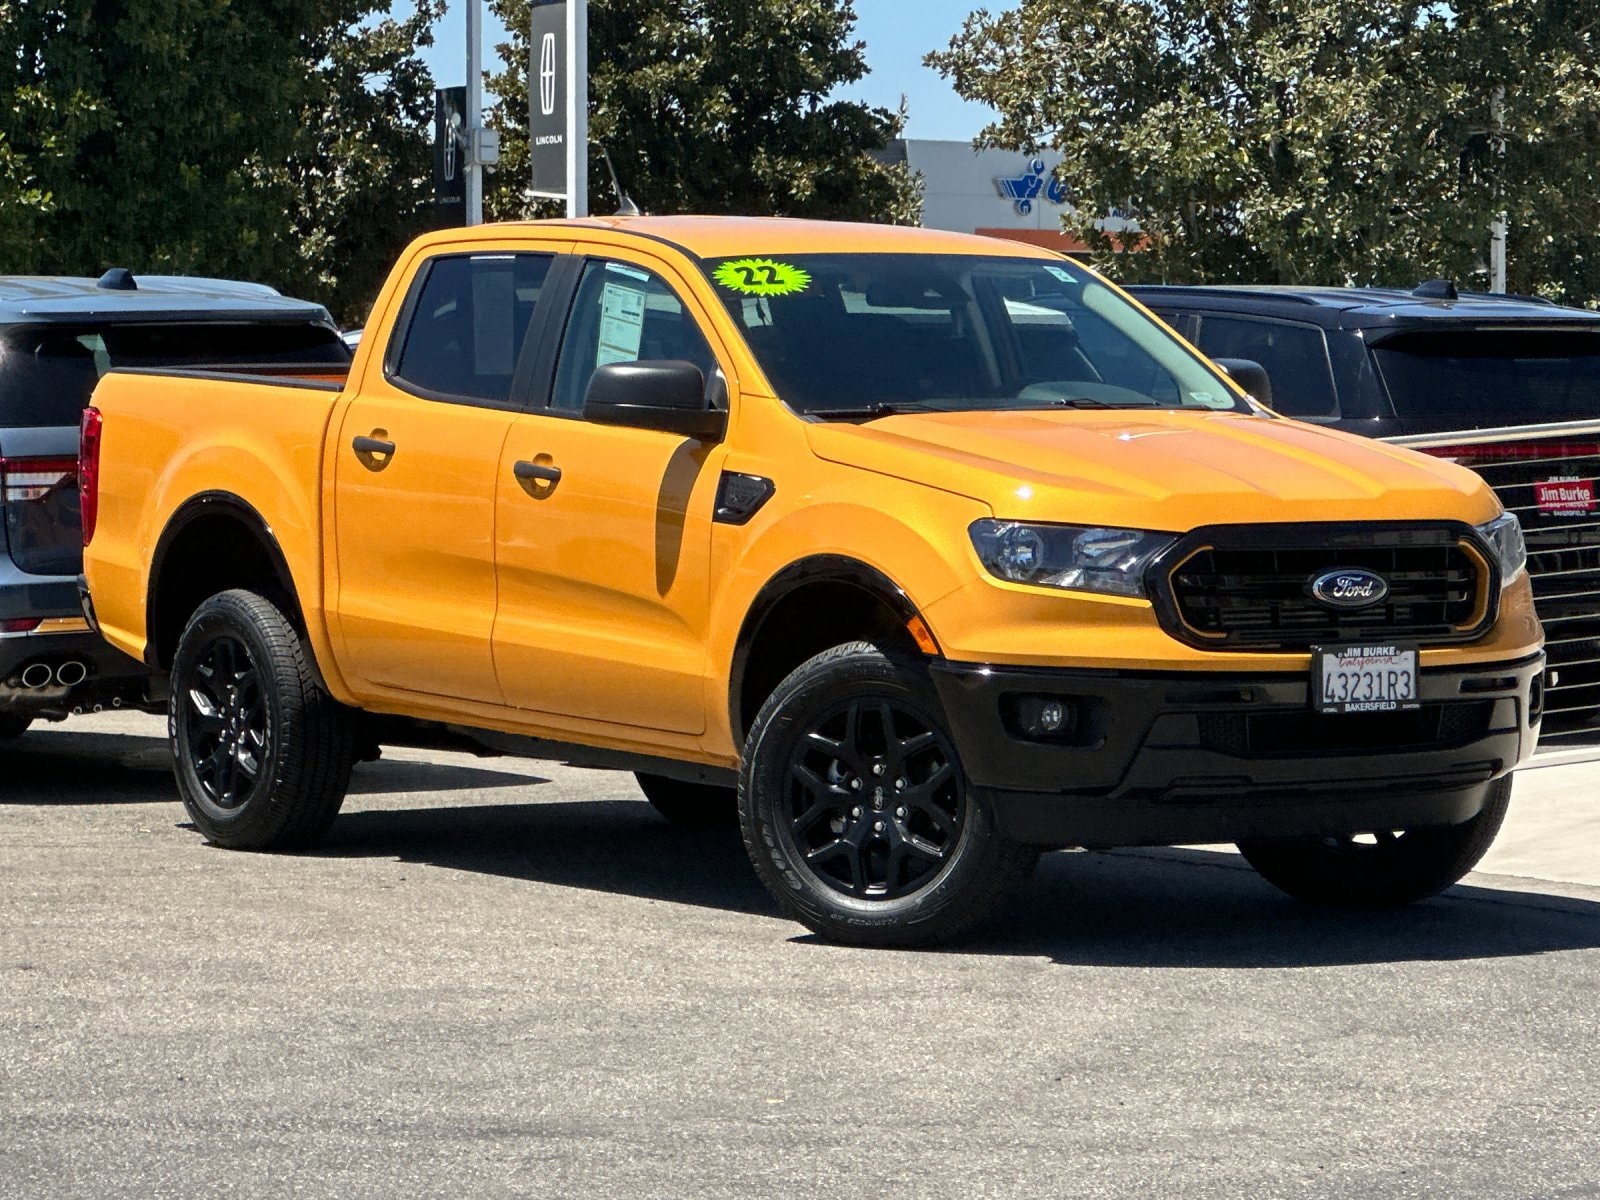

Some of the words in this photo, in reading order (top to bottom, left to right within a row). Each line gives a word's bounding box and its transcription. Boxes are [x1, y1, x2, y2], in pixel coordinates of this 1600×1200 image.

[535, 134, 563, 146] LINCOLN
[734, 265, 785, 286] 22
[1541, 487, 1559, 501] Jim
[1559, 487, 1590, 501] Burke
[1333, 576, 1373, 597] Ford
[1344, 648, 1361, 657] JIM
[1363, 646, 1396, 657] BURKE
[1325, 671, 1411, 702] 43231R3
[1345, 701, 1397, 712] BAKERSFIELD
